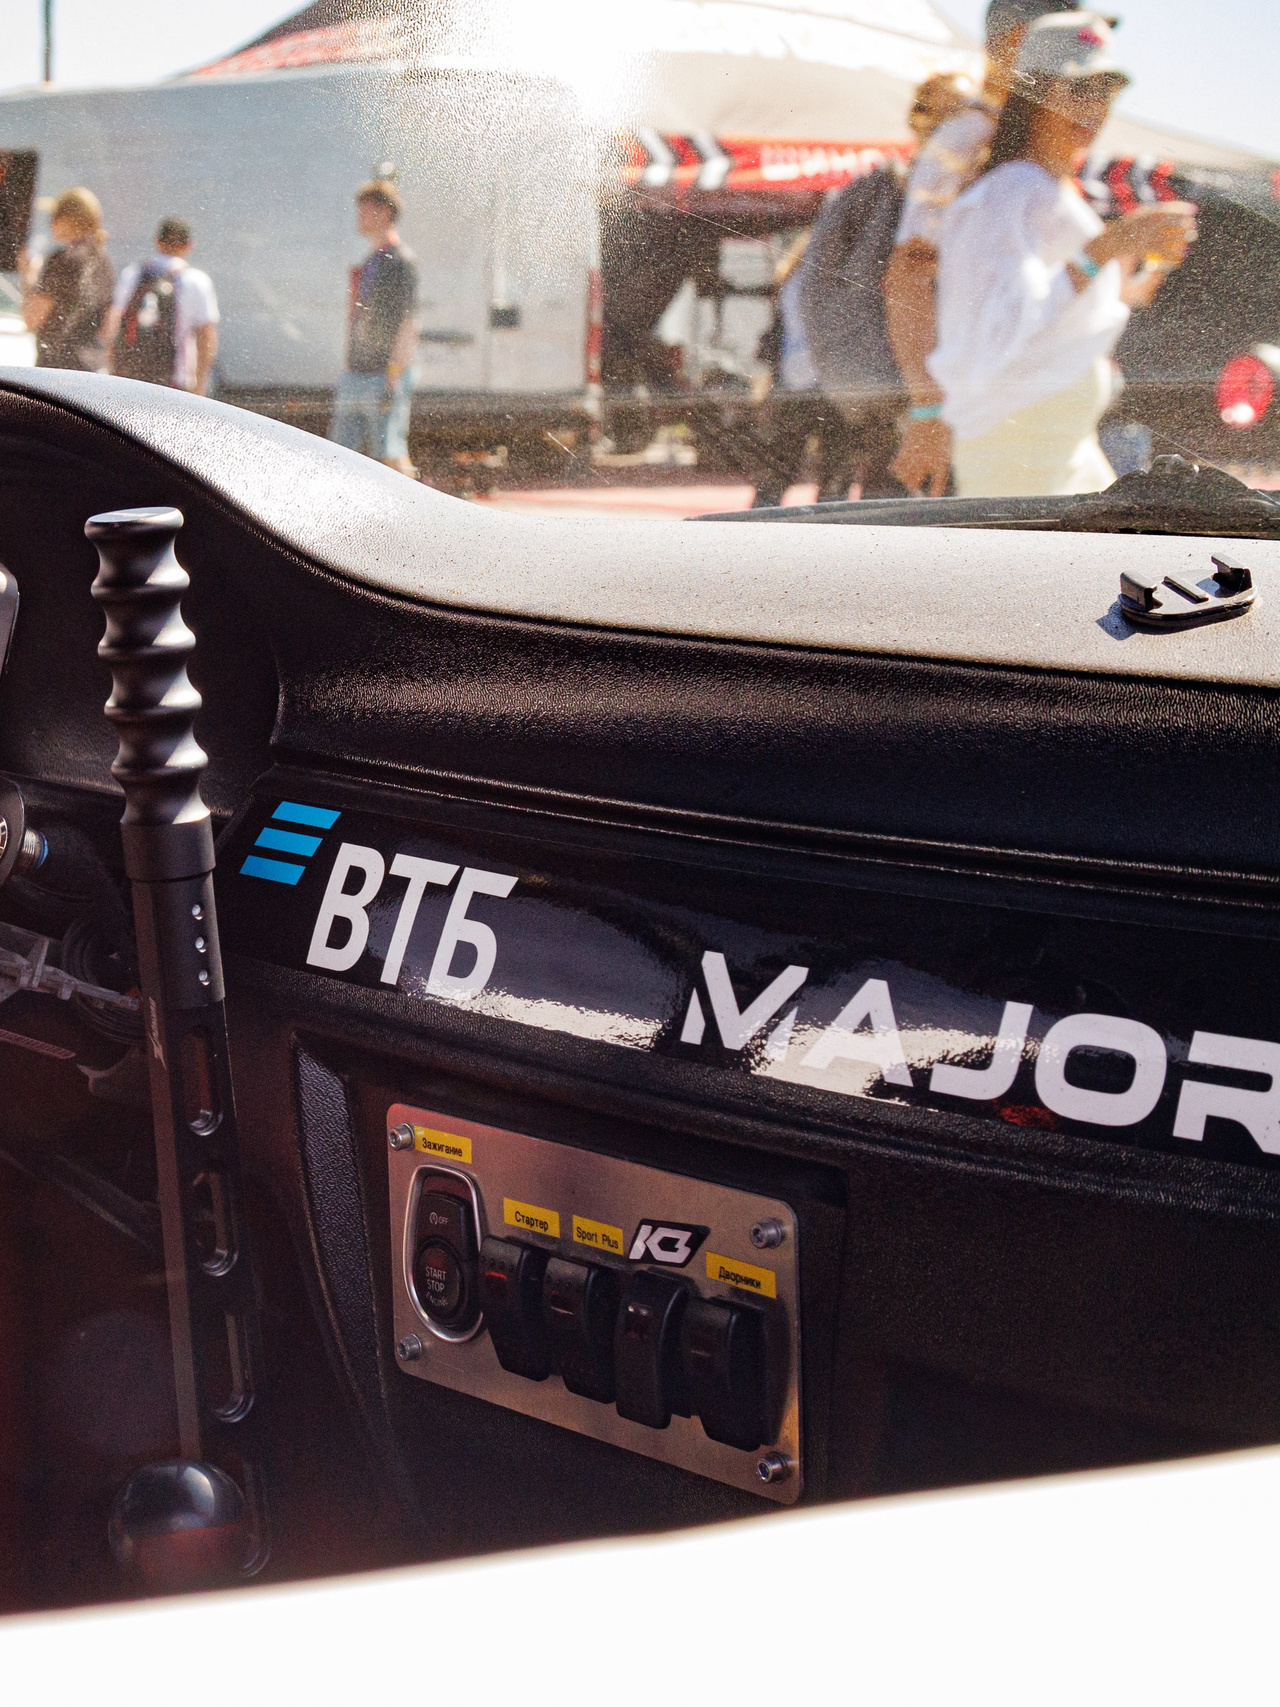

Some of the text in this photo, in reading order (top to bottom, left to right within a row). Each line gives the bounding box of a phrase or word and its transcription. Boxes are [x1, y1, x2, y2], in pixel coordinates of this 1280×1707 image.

[306, 842, 519, 1001] ВТБ
[680, 950, 1280, 1155] MAJOR
[422, 1137, 463, 1157] Зажигание
[438, 1215, 449, 1225] OFF
[514, 1210, 549, 1232] Стартер
[576, 1226, 619, 1249] Sport Plus
[425, 1265, 447, 1281] START
[718, 1266, 762, 1290] Дворники
[427, 1279, 445, 1293] STOP
